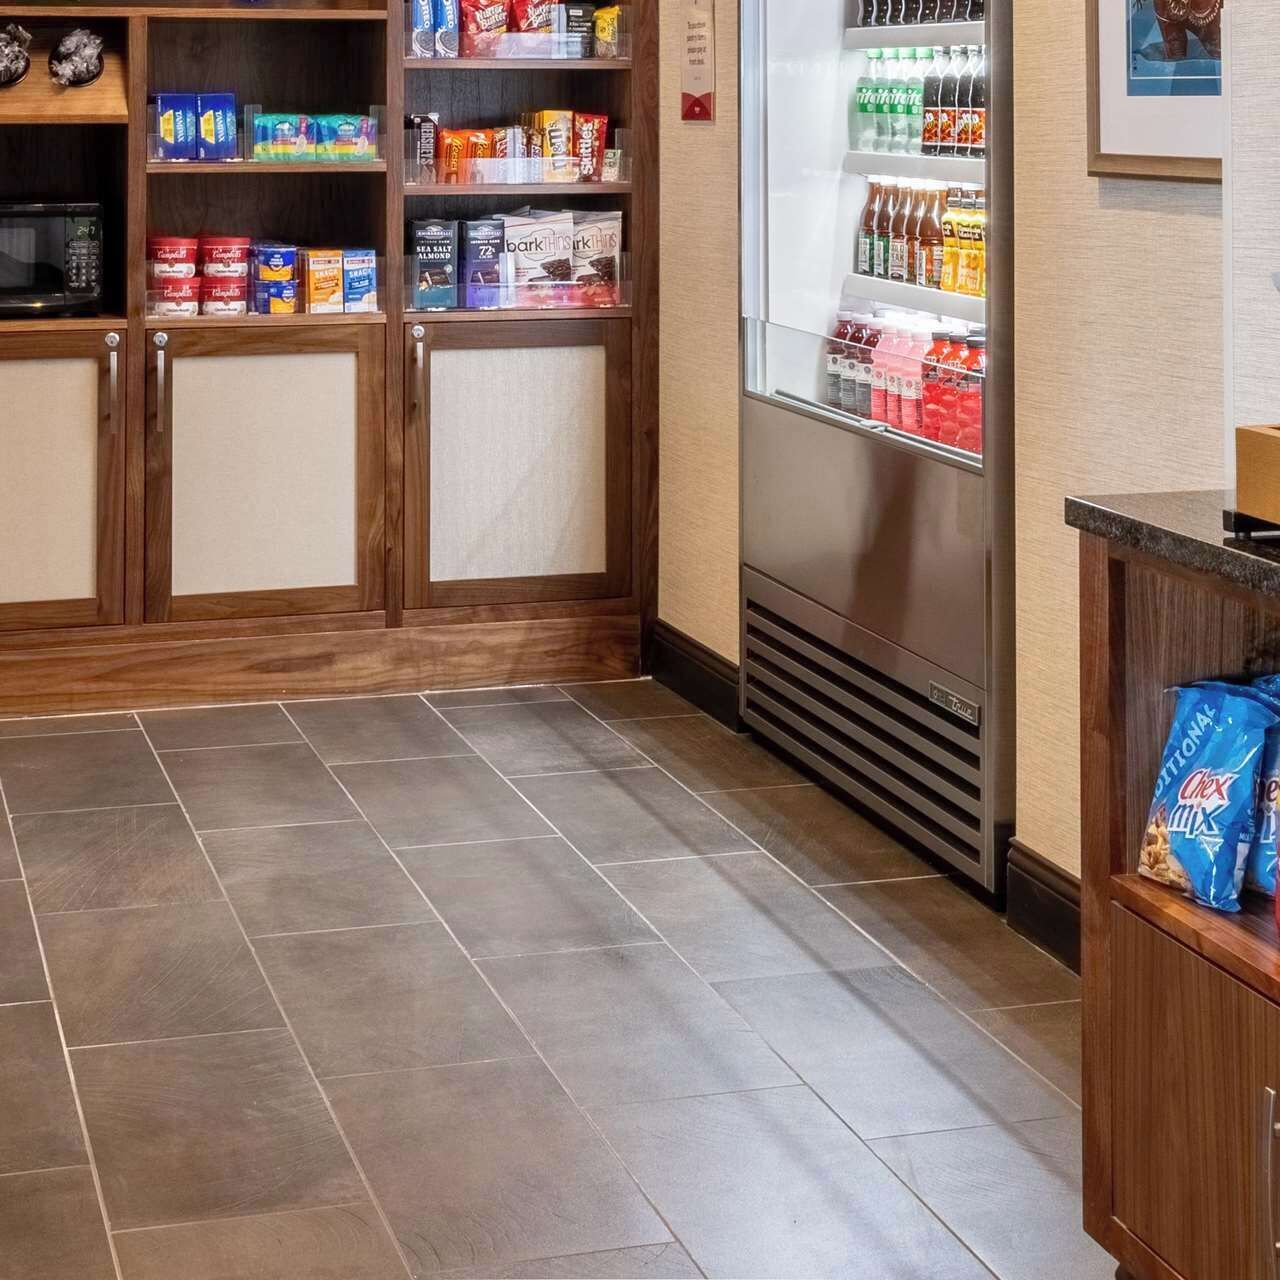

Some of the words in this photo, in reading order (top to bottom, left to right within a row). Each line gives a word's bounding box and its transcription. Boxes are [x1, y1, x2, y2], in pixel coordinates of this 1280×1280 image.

[475, 5, 504, 21] Nutter
[480, 12, 508, 30] Butter
[175, 109, 186, 143] TAMPAX
[215, 109, 225, 143] TAMPAX
[581, 122, 594, 175] Skittles
[416, 245, 432, 253] SEA
[433, 245, 453, 253] SALT
[418, 252, 452, 260] ALMOND
[1153, 703, 1218, 799] DITIONAL
[1180, 771, 1228, 801] Chex
